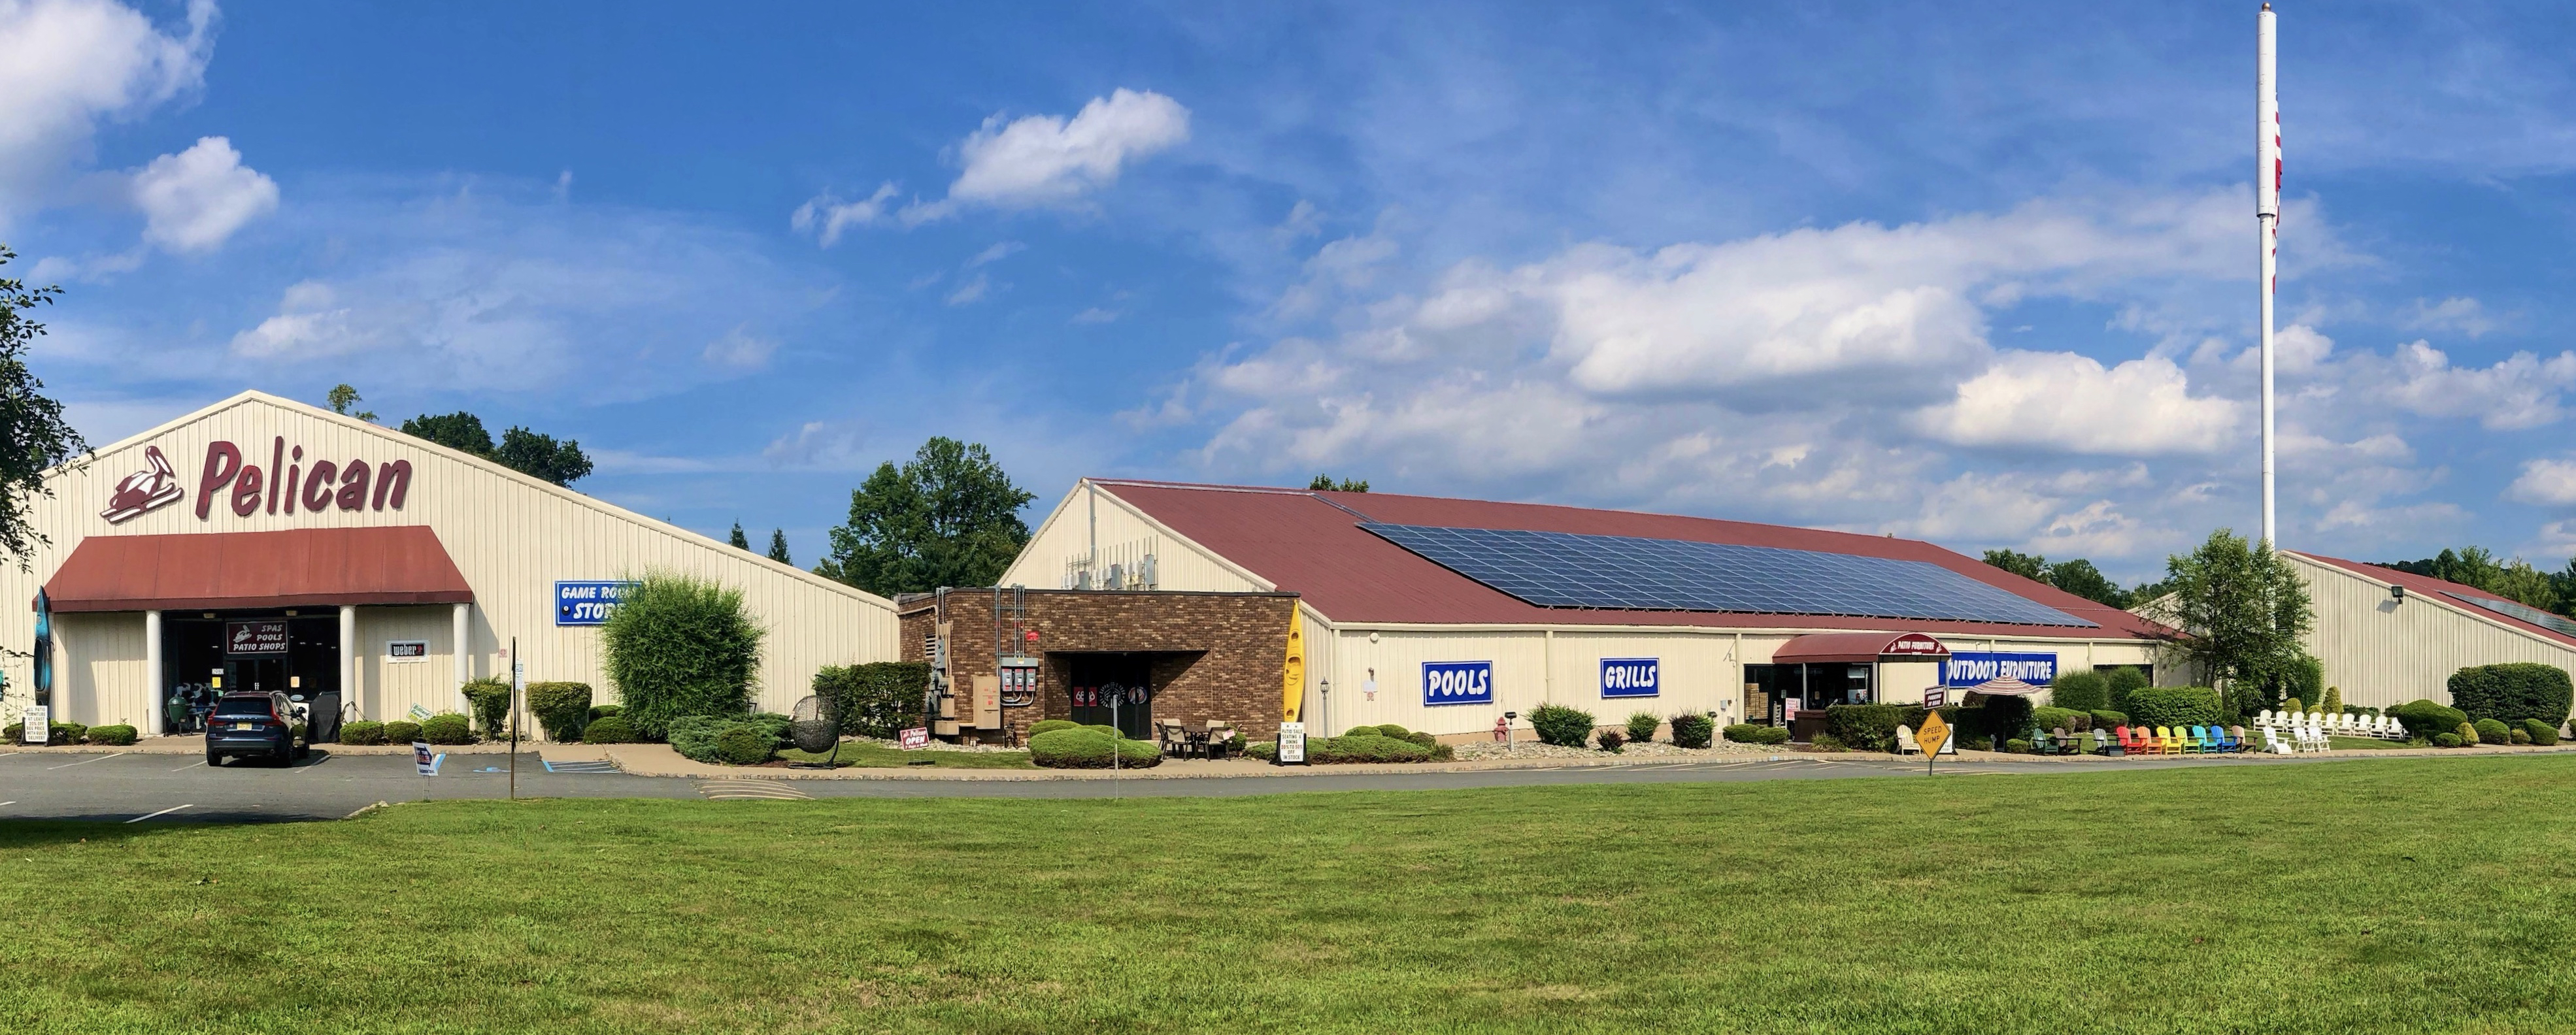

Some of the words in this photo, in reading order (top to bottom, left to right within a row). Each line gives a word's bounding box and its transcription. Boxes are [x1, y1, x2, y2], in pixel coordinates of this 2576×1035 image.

[195, 436, 412, 519] Pelican
[561, 587, 596, 599] GAME
[259, 642, 286, 651] SHOPS
[393, 643, 417, 656] weber
[1898, 640, 1911, 649] PATIO
[1911, 641, 1935, 650] FURNITURE
[1948, 660, 1998, 680] OUTDOOR
[2000, 660, 2052, 681] FURNITURE
[1428, 668, 1488, 697] POOLS
[1605, 665, 1656, 690] GRILLS
[1924, 726, 1942, 735] SPEED
[905, 736, 926, 745] OPEN
[1924, 735, 1940, 744] HUMP
